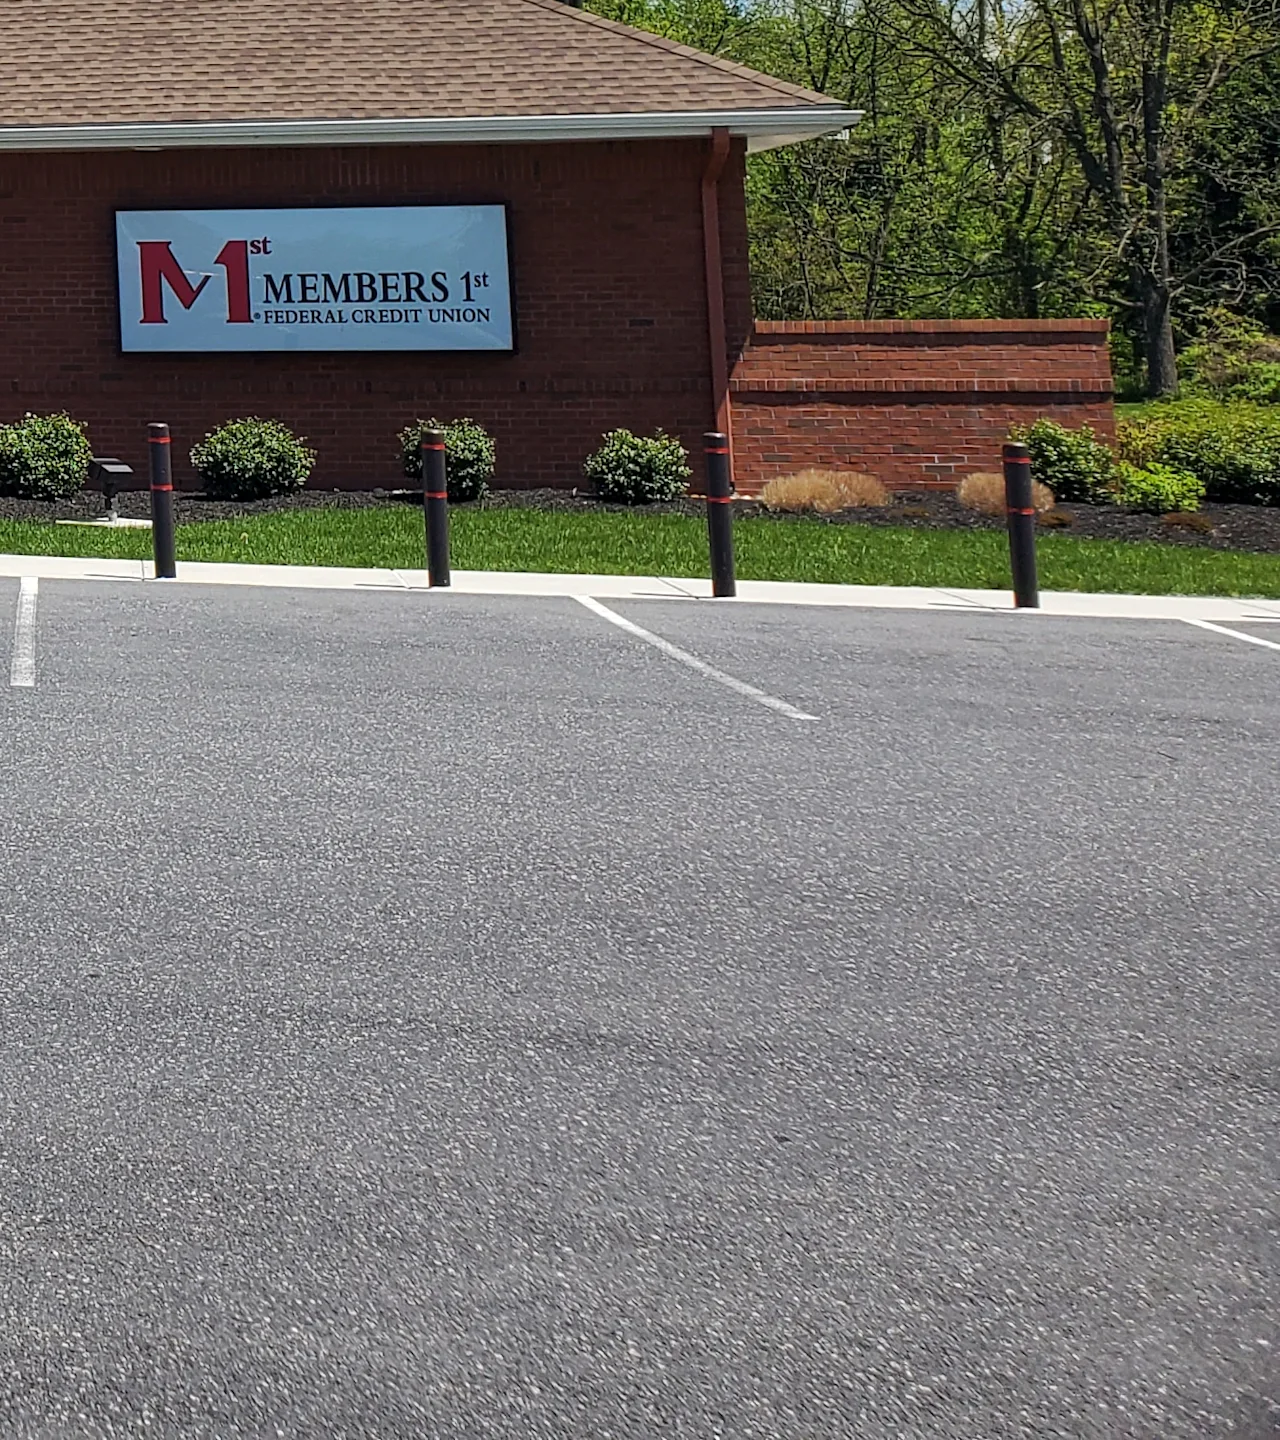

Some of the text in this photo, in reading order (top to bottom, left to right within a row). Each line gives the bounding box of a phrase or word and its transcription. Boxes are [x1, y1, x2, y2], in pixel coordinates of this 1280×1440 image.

[262, 270, 490, 303] MEMBERS 1st
[263, 308, 491, 324] FEDERAL CREDIT UNION
